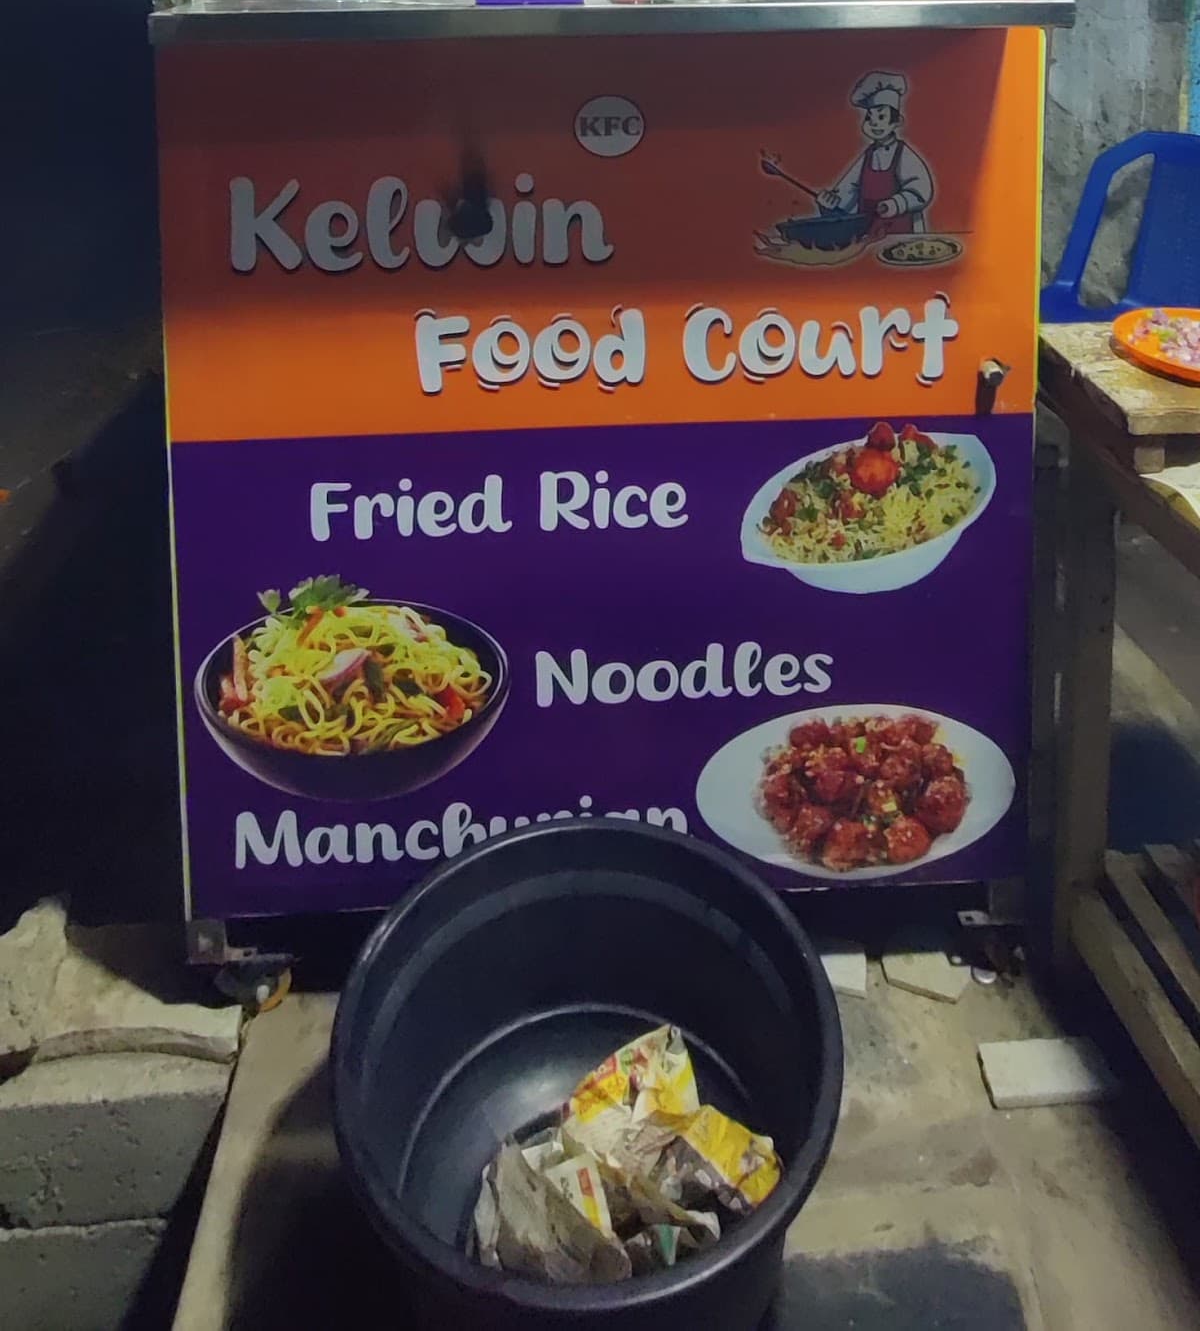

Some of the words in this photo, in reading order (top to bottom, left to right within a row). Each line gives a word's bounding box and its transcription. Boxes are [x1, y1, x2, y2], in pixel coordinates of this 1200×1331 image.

[577, 113, 642, 138] KFC
[229, 173, 614, 272] Kelwin
[413, 304, 646, 395] Food
[682, 292, 959, 387] Court
[310, 473, 512, 542] Fried
[539, 470, 690, 532] Rice
[535, 642, 834, 708] Noodles
